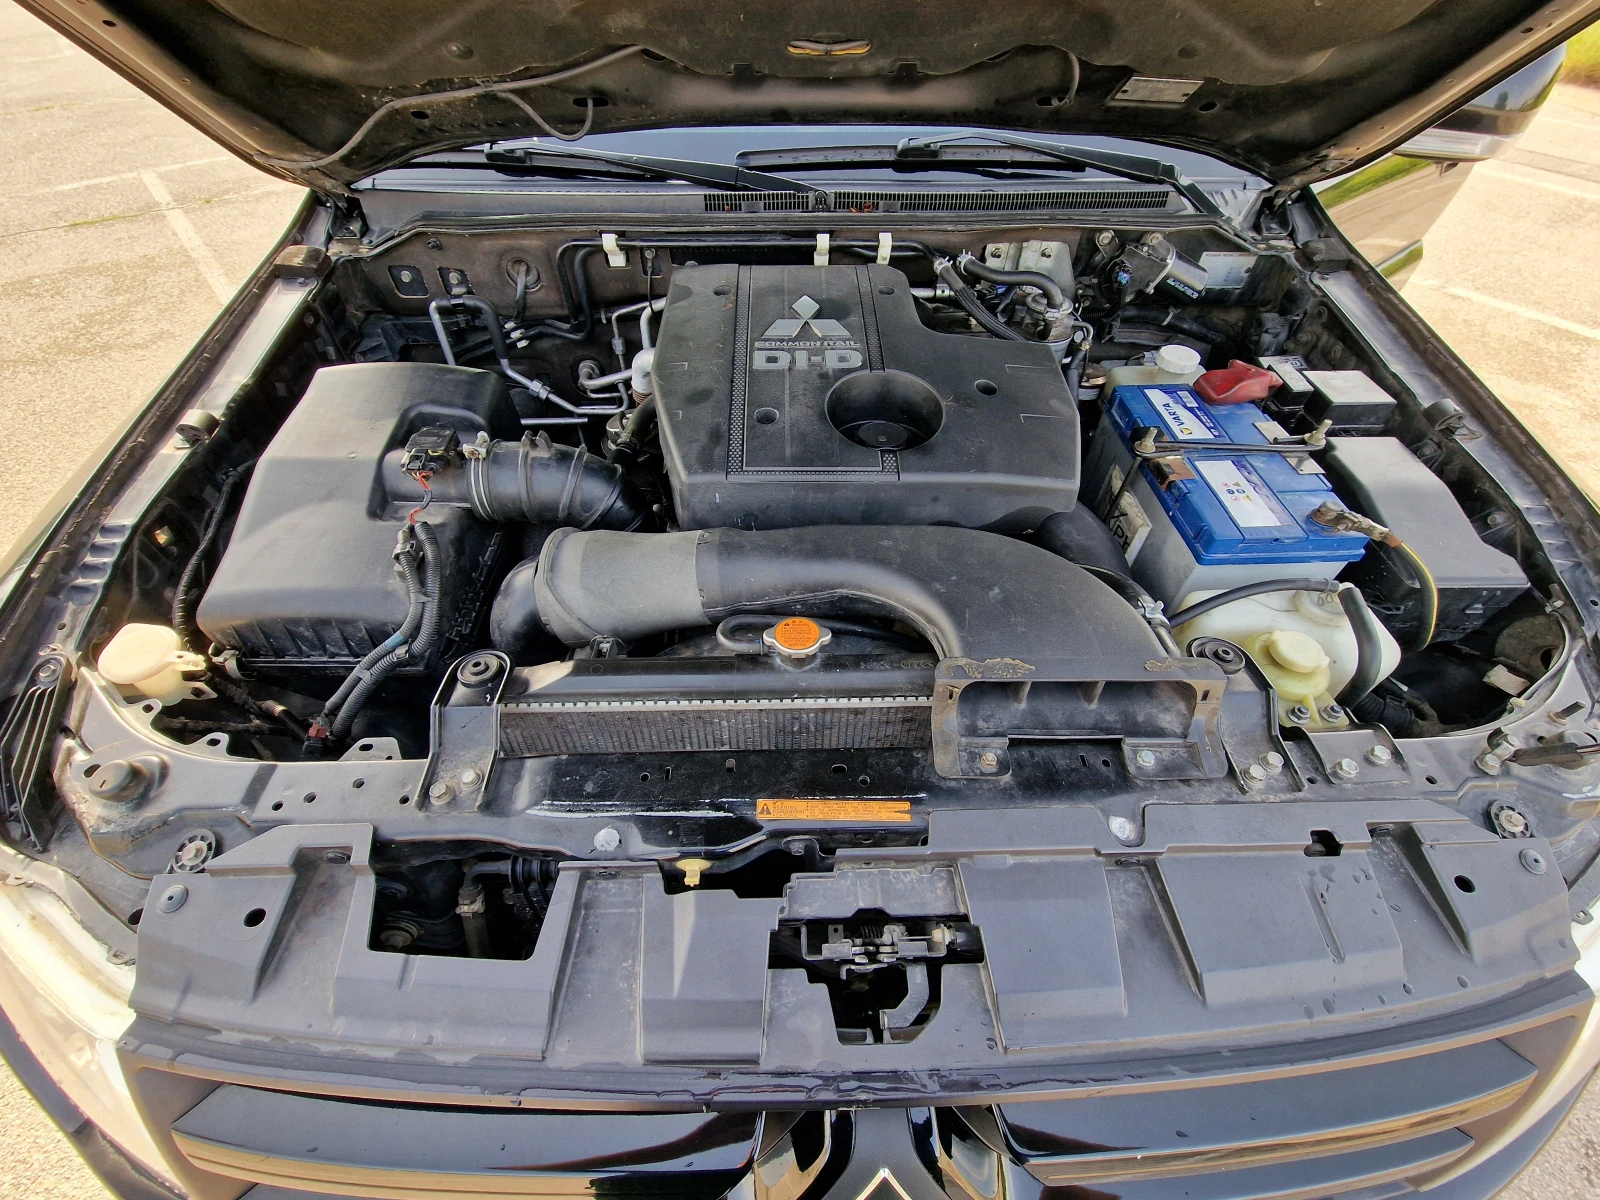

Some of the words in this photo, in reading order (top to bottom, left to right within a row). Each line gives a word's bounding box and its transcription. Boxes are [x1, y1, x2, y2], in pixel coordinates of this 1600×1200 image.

[754, 340, 821, 348] COMMON
[823, 340, 860, 348] RAIL
[752, 349, 863, 369] DI-D
[1162, 402, 1185, 427] VARTA
